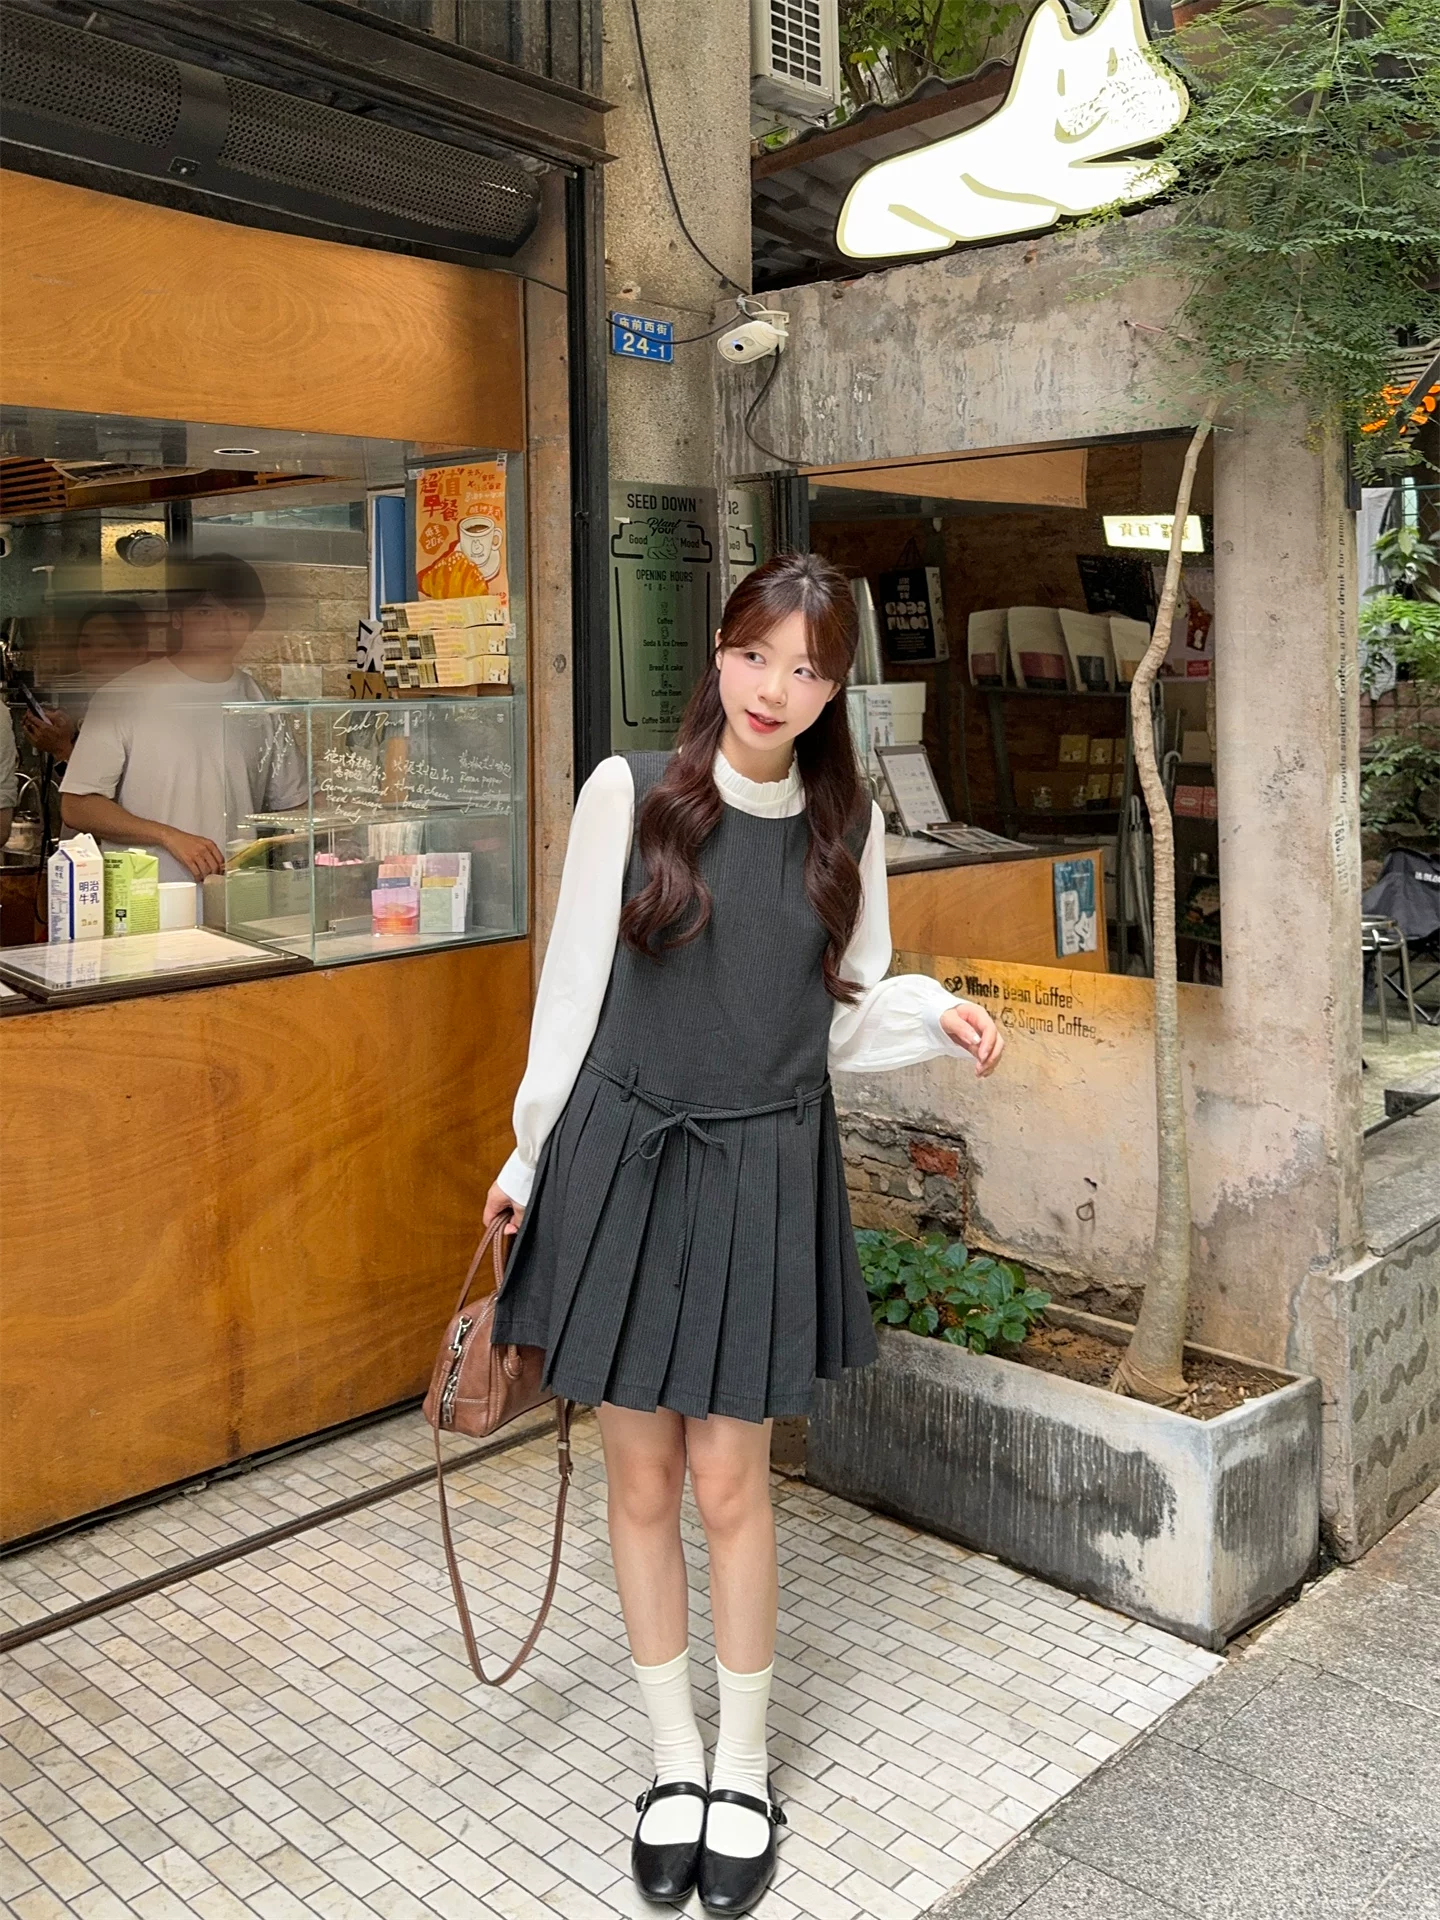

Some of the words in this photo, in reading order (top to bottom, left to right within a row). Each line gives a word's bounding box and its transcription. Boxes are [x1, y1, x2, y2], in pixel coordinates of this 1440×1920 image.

[619, 317, 667, 336] 庙前西街
[623, 332, 665, 358] 24-1
[422, 494, 459, 521] 早餐
[627, 493, 657, 510] SEED
[662, 496, 696, 513] DOWN
[646, 517, 681, 529] Plant
[628, 534, 648, 545] Good
[680, 537, 700, 549] Mood
[636, 569, 667, 581] OPENING
[670, 570, 693, 582] HOURS
[1337, 574, 1345, 606] drink
[1338, 609, 1347, 638] daily
[1337, 654, 1346, 694] coffee
[1338, 697, 1347, 753] selected
[1339, 755, 1347, 803] Provide
[79, 881, 100, 892] 明治
[79, 892, 100, 905] 牛乳
[964, 975, 1000, 999] Whole
[1035, 984, 1073, 1009] Coffee
[1018, 1009, 1054, 1035] Sigma
[1057, 1013, 1097, 1040] Coffee
